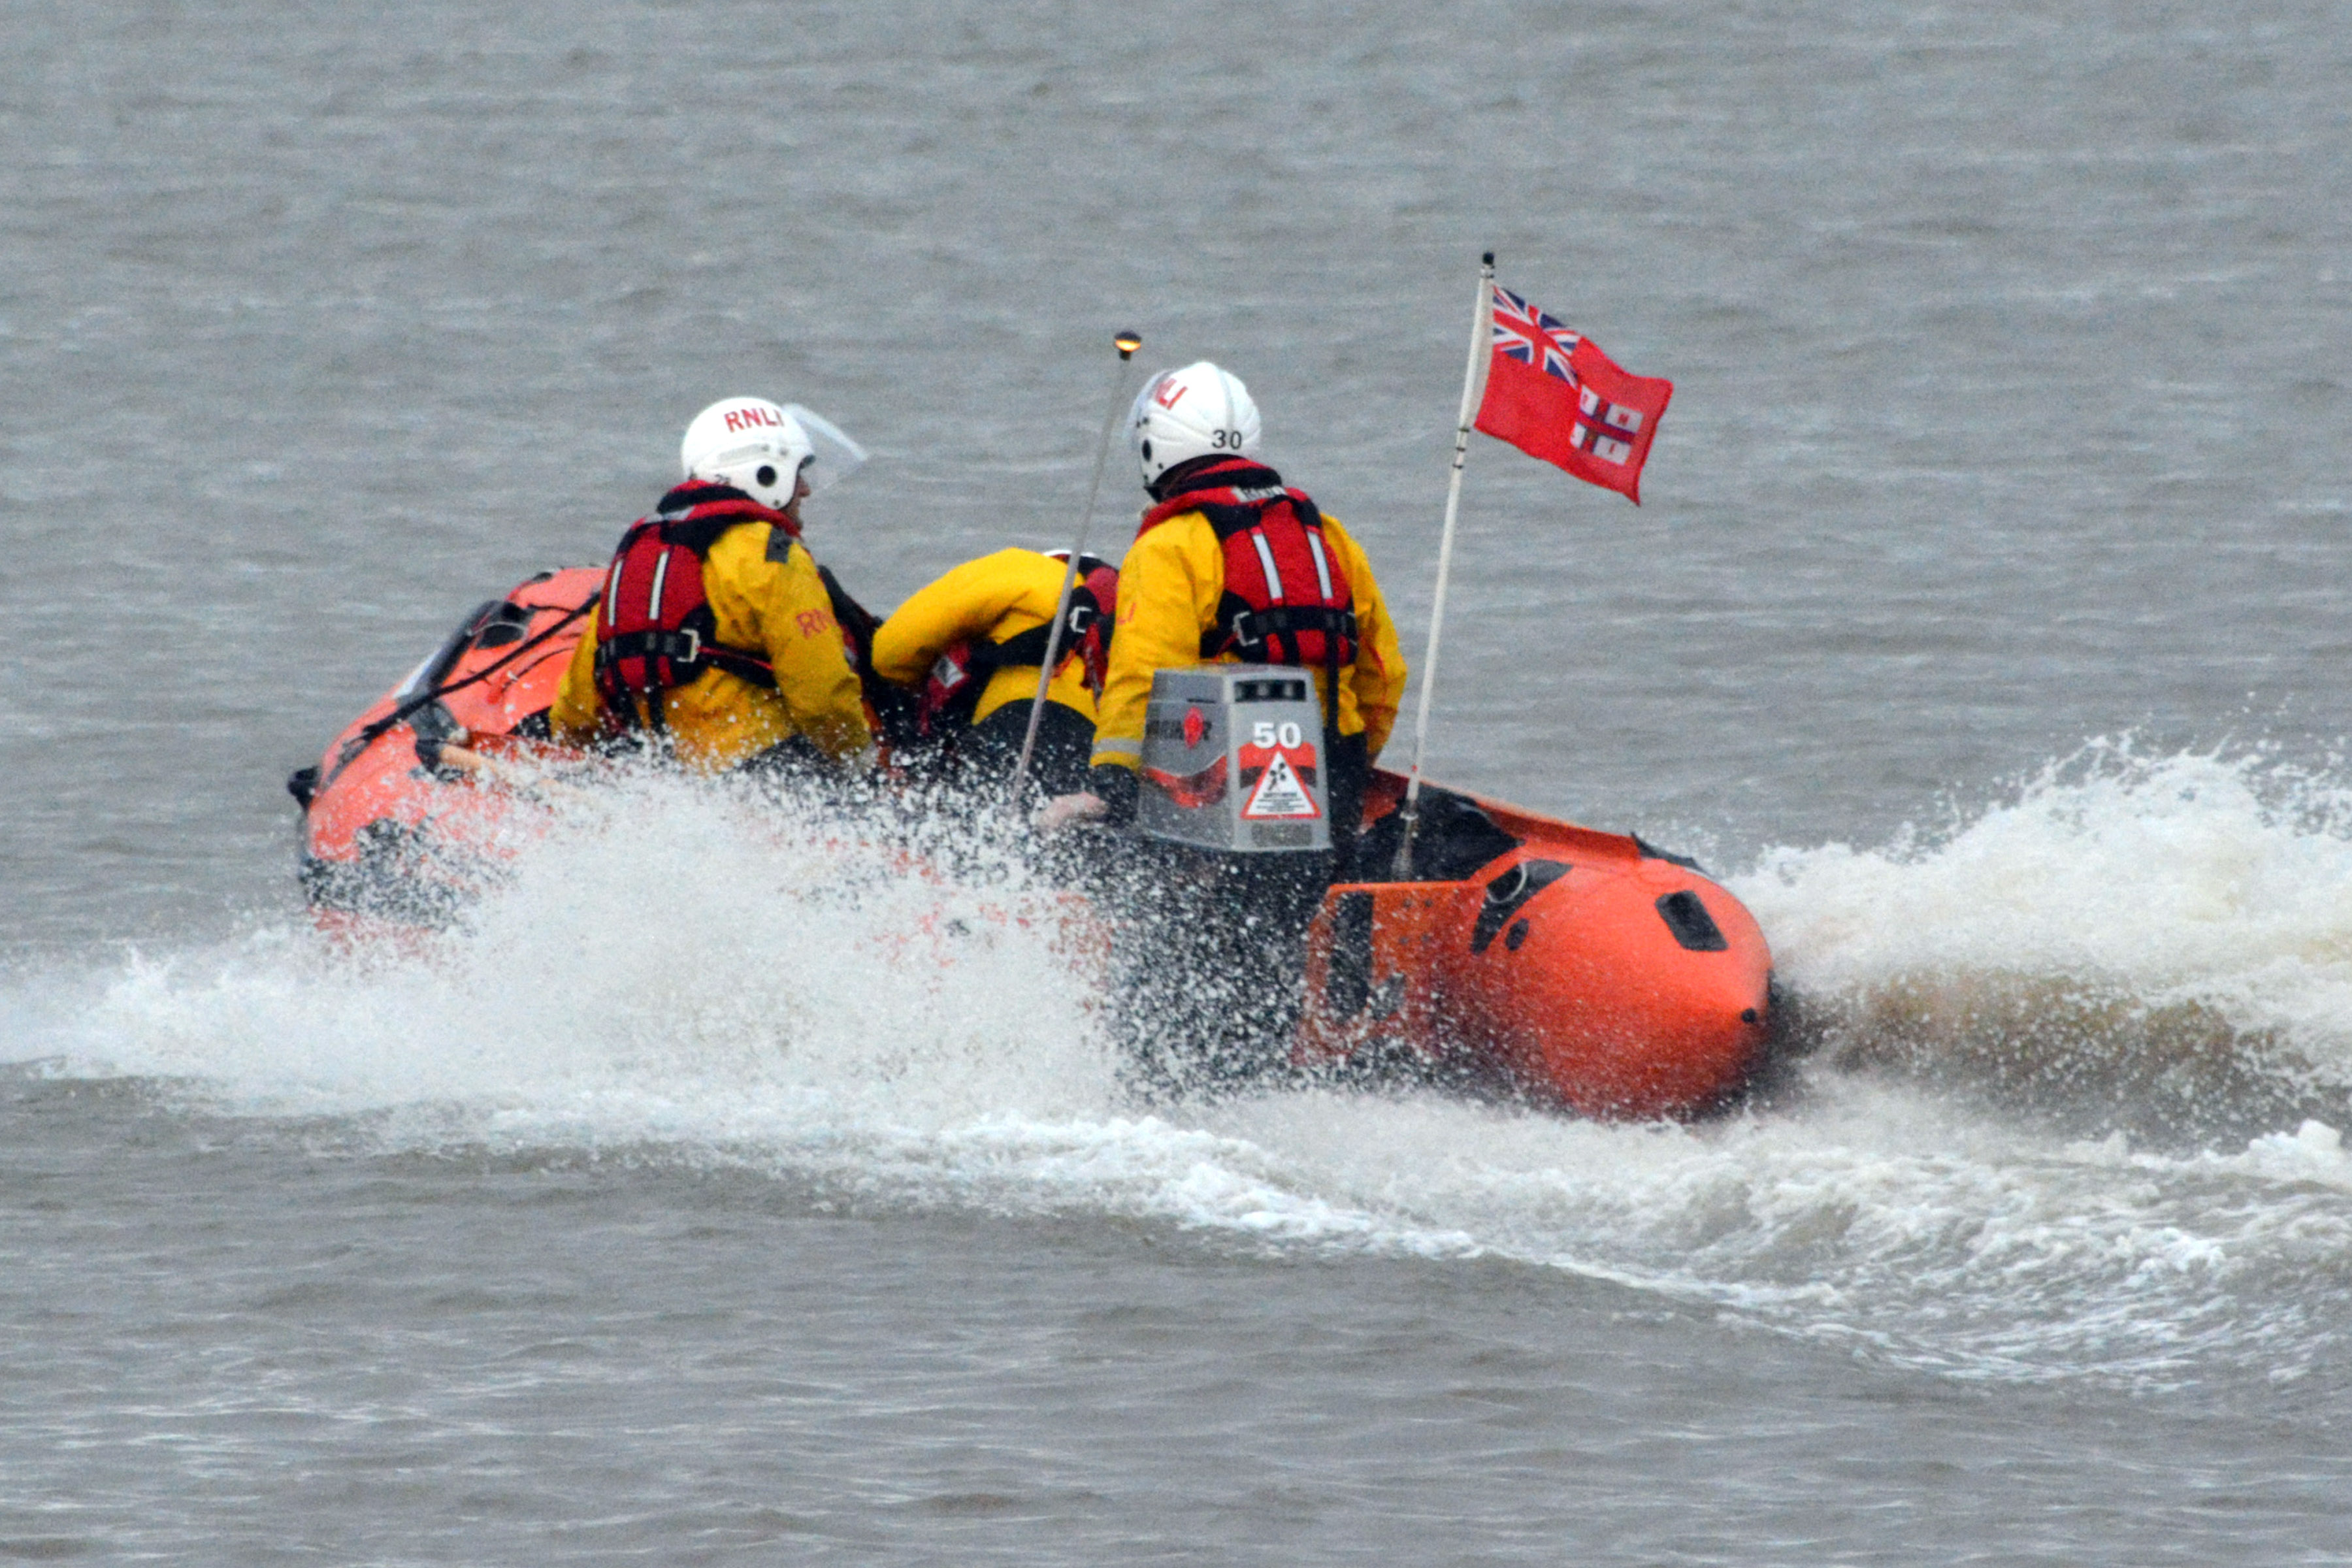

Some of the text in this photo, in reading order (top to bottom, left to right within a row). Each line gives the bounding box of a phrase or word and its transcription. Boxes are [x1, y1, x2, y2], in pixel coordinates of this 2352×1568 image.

[724, 407, 784, 433] RNLI
[1212, 429, 1242, 450] 30
[1252, 721, 1302, 749] 50
